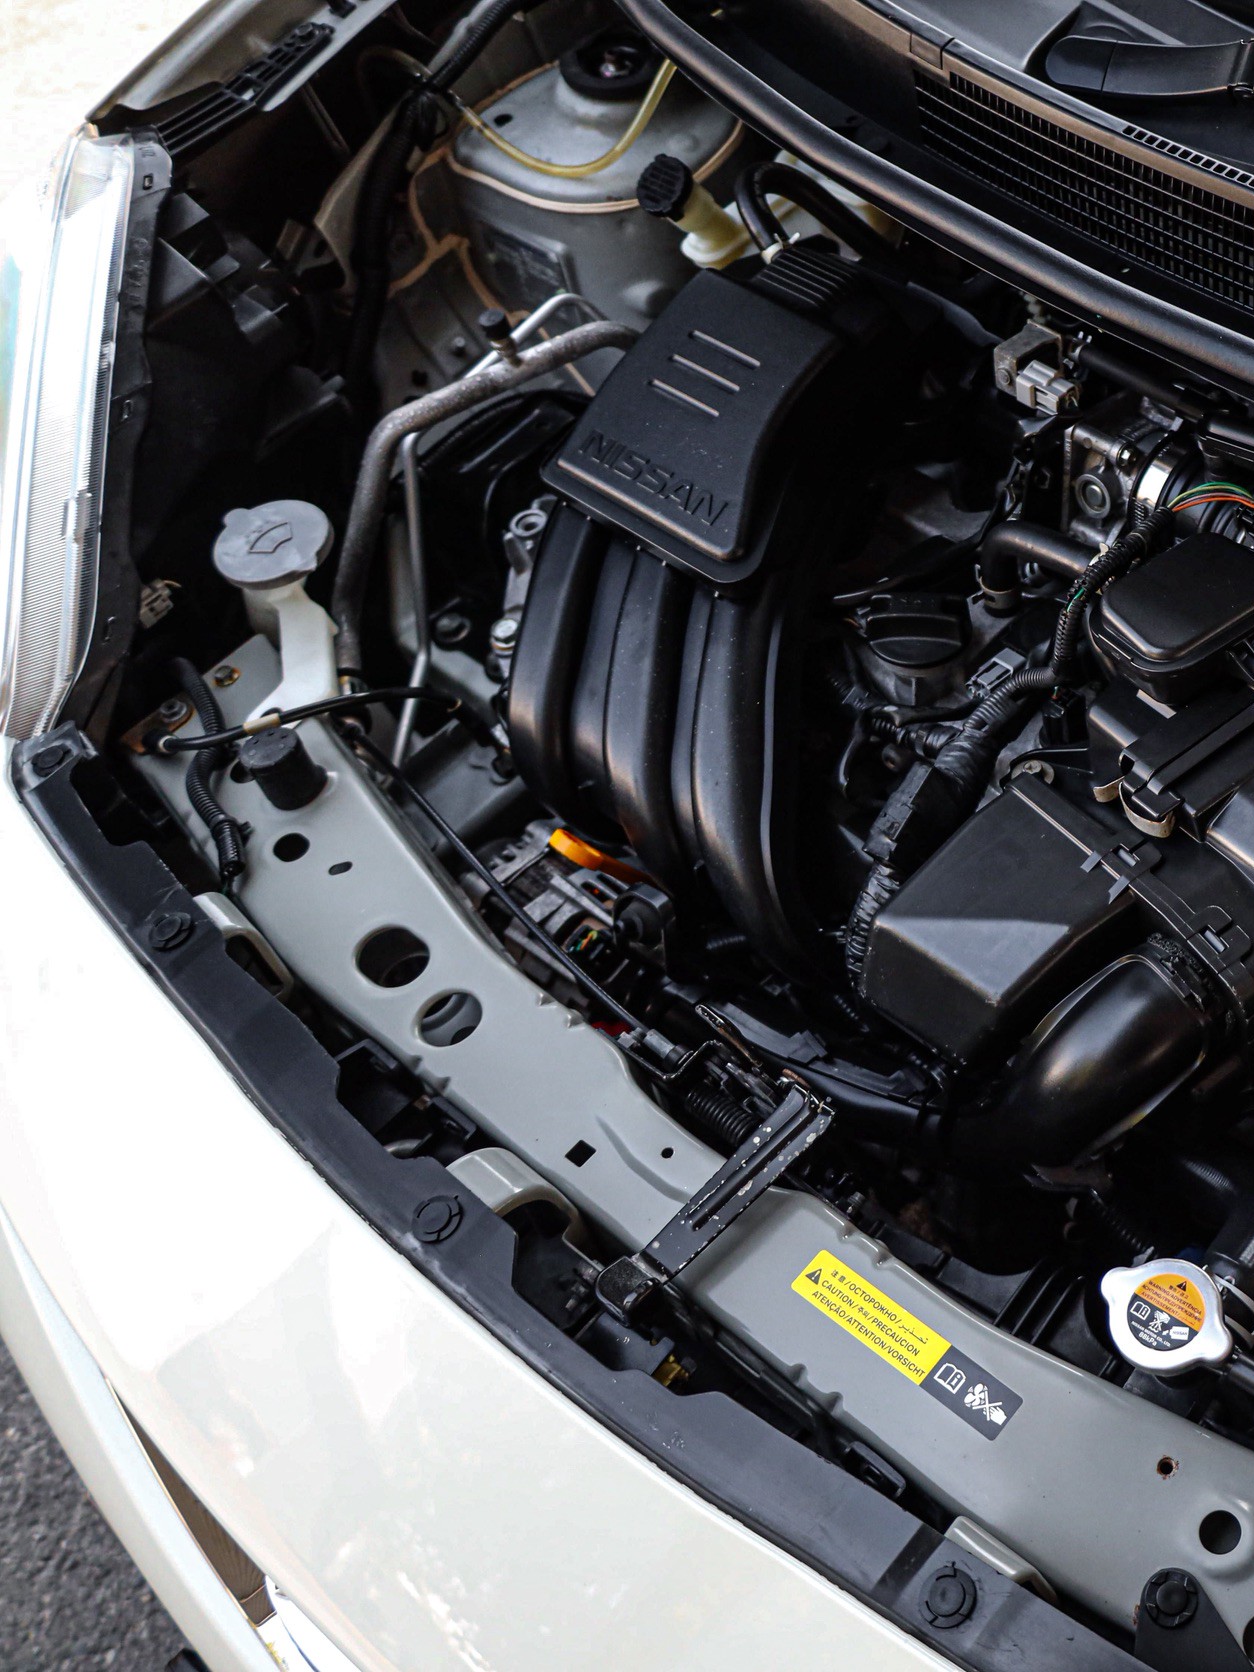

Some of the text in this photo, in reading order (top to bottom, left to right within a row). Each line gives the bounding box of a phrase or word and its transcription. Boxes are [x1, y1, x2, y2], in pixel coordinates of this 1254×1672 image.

[578, 430, 730, 527] NISSAN
[820, 1279, 854, 1307] CAUTION
[870, 1316, 920, 1356] PRECAUCION
[848, 1282, 897, 1322] ОСТОРОЖНО
